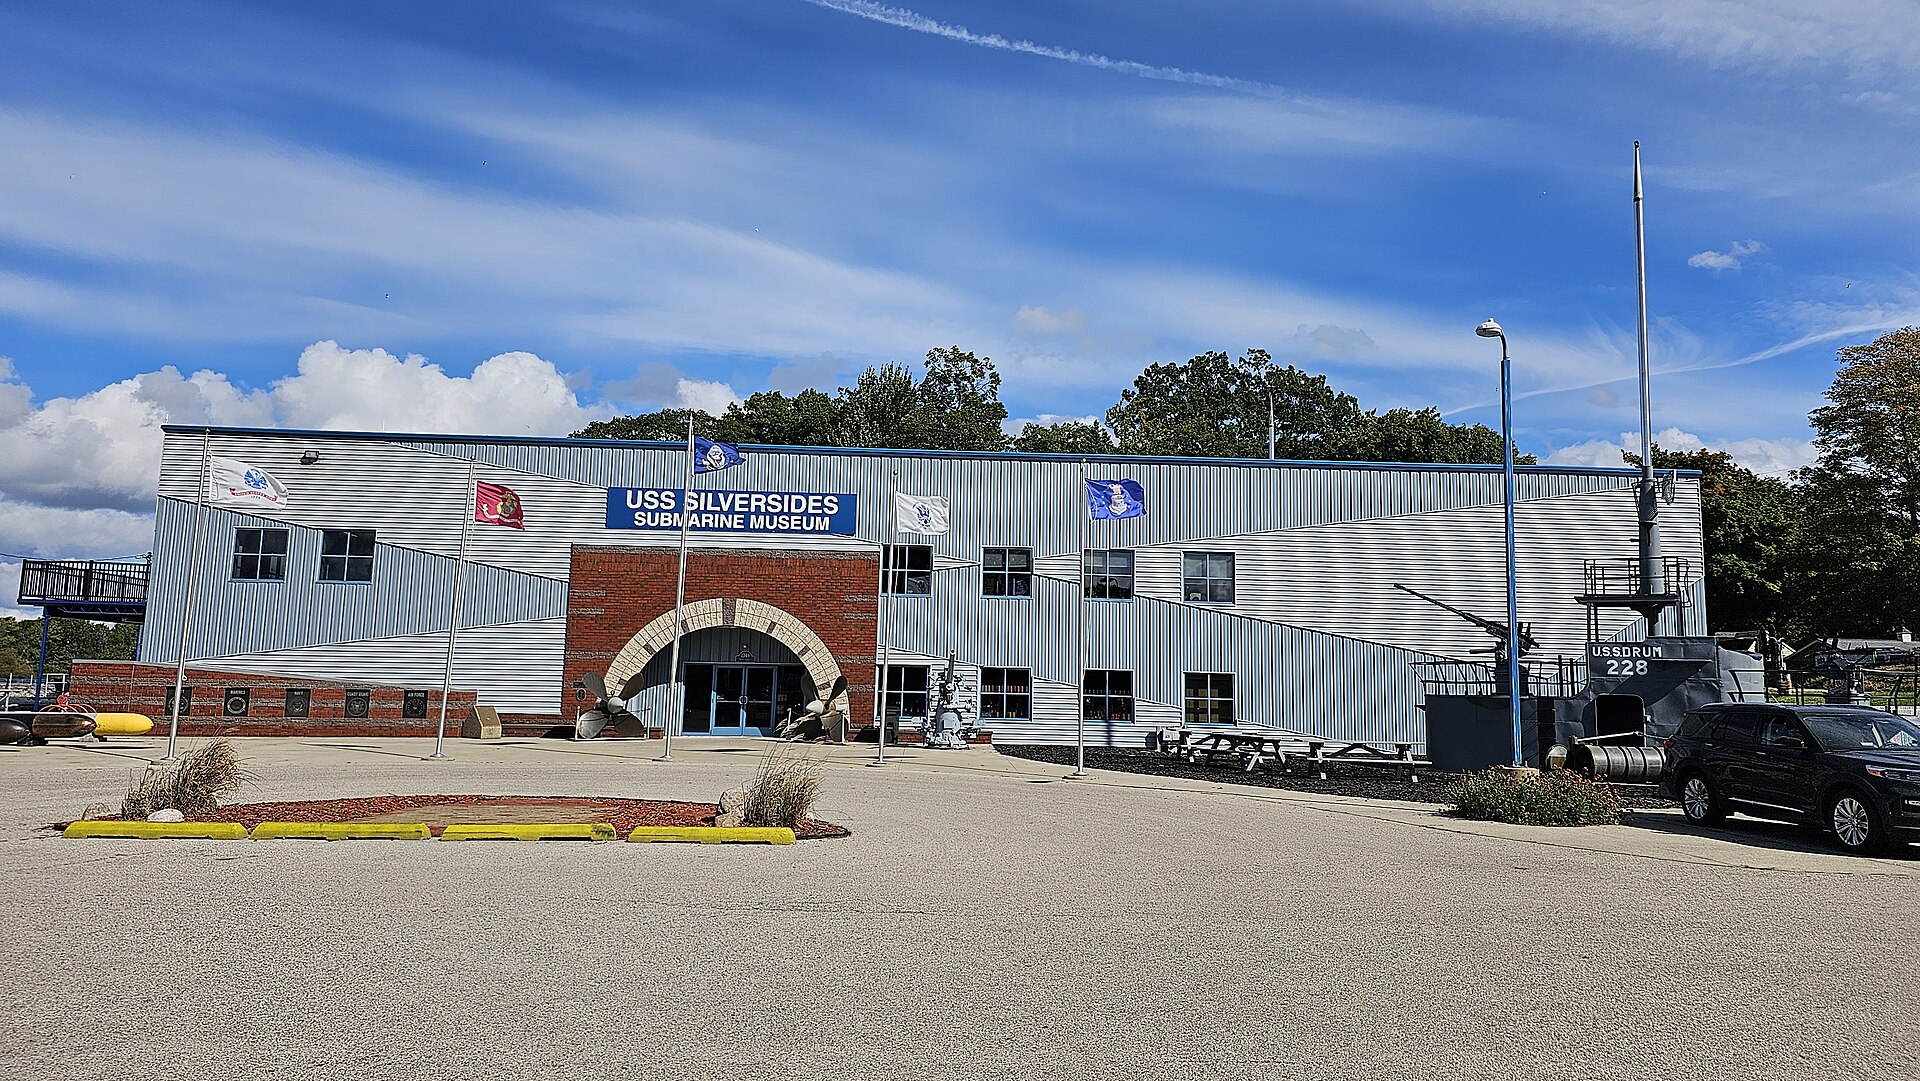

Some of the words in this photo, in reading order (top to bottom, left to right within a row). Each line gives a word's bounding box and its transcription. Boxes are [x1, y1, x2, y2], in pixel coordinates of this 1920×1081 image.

[626, 489, 676, 510] USS
[686, 491, 839, 515] SILVERSIDES
[633, 511, 745, 529] SUBMARINE
[750, 514, 830, 531] MUSEUM
[1606, 659, 1648, 676] 228
